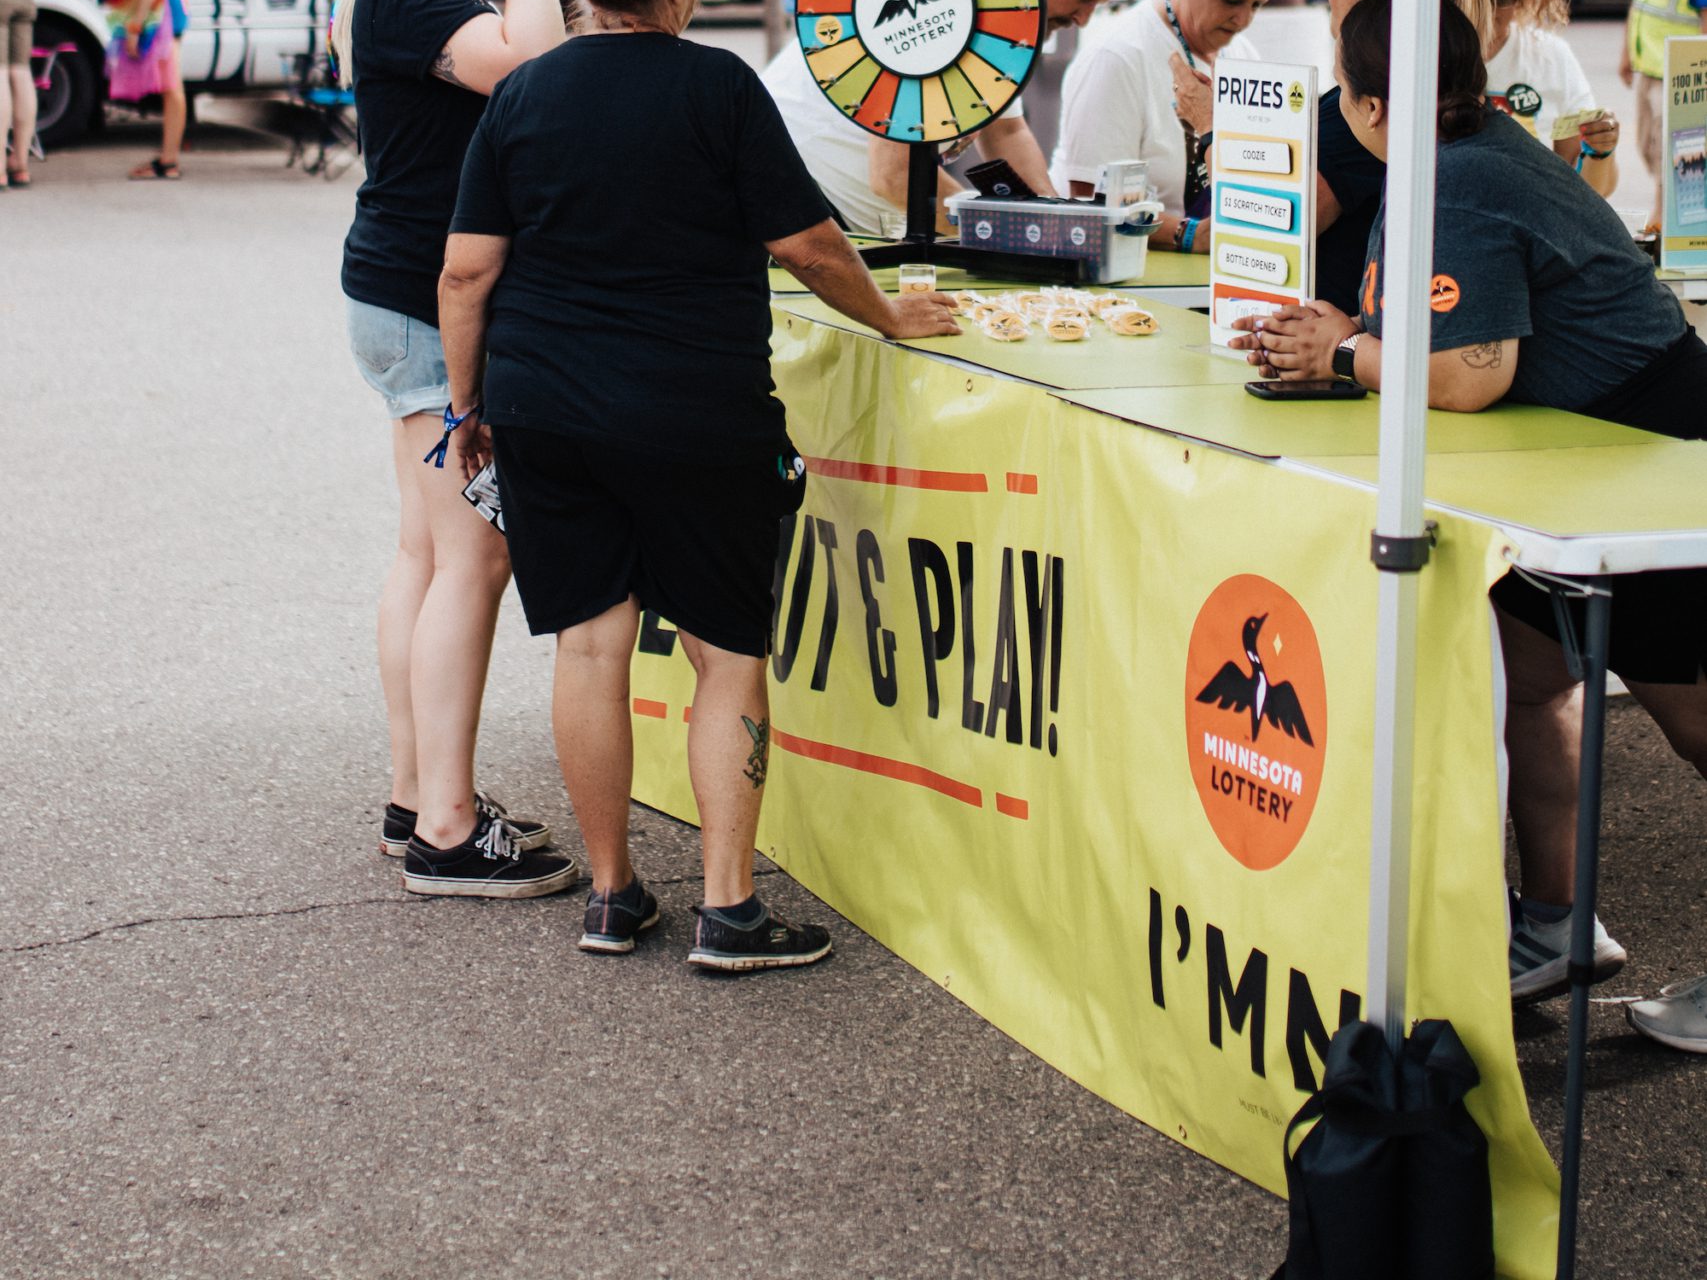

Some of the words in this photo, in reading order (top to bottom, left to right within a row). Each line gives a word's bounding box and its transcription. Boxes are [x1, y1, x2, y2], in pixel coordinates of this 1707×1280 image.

[884, 8, 956, 45] MINNESOTA
[893, 22, 954, 55] LOTTERY
[1218, 76, 1283, 109] PRIZES
[1508, 89, 1540, 111] 728
[1242, 150, 1266, 161] COOZIE
[1233, 198, 1263, 214] SCRATCH
[1264, 204, 1287, 218] TICKET
[1226, 252, 1249, 267] BOTTLE
[1250, 258, 1277, 272] OPENER
[772, 513, 839, 692] UT
[856, 529, 898, 708] &
[908, 537, 1065, 758] PLAY!
[1203, 731, 1303, 796] MINNESOTA
[1211, 765, 1293, 823] LOTTERY
